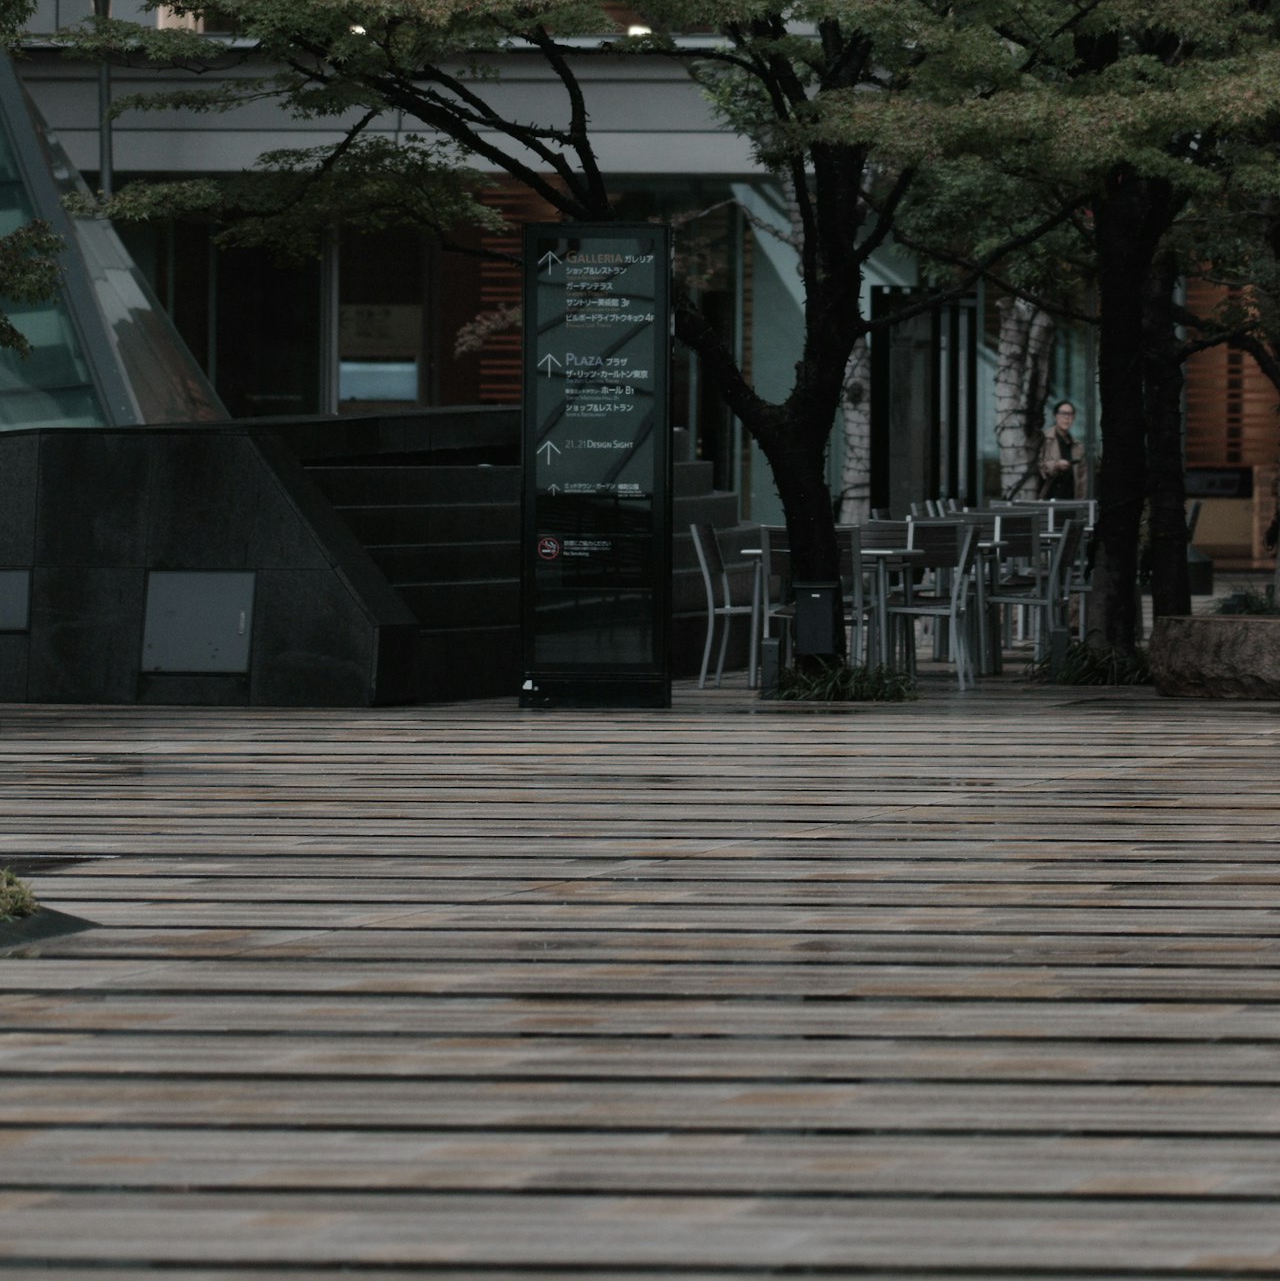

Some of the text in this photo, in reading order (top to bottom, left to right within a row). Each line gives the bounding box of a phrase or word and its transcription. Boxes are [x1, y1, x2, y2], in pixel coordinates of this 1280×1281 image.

[566, 250, 655, 264] GALLERIA ガレリア
[566, 281, 614, 291] ガーデンテラス
[566, 352, 629, 367] PLAZA プラザ
[586, 439, 613, 450] DESIGN
[612, 439, 634, 449] SIGHT
